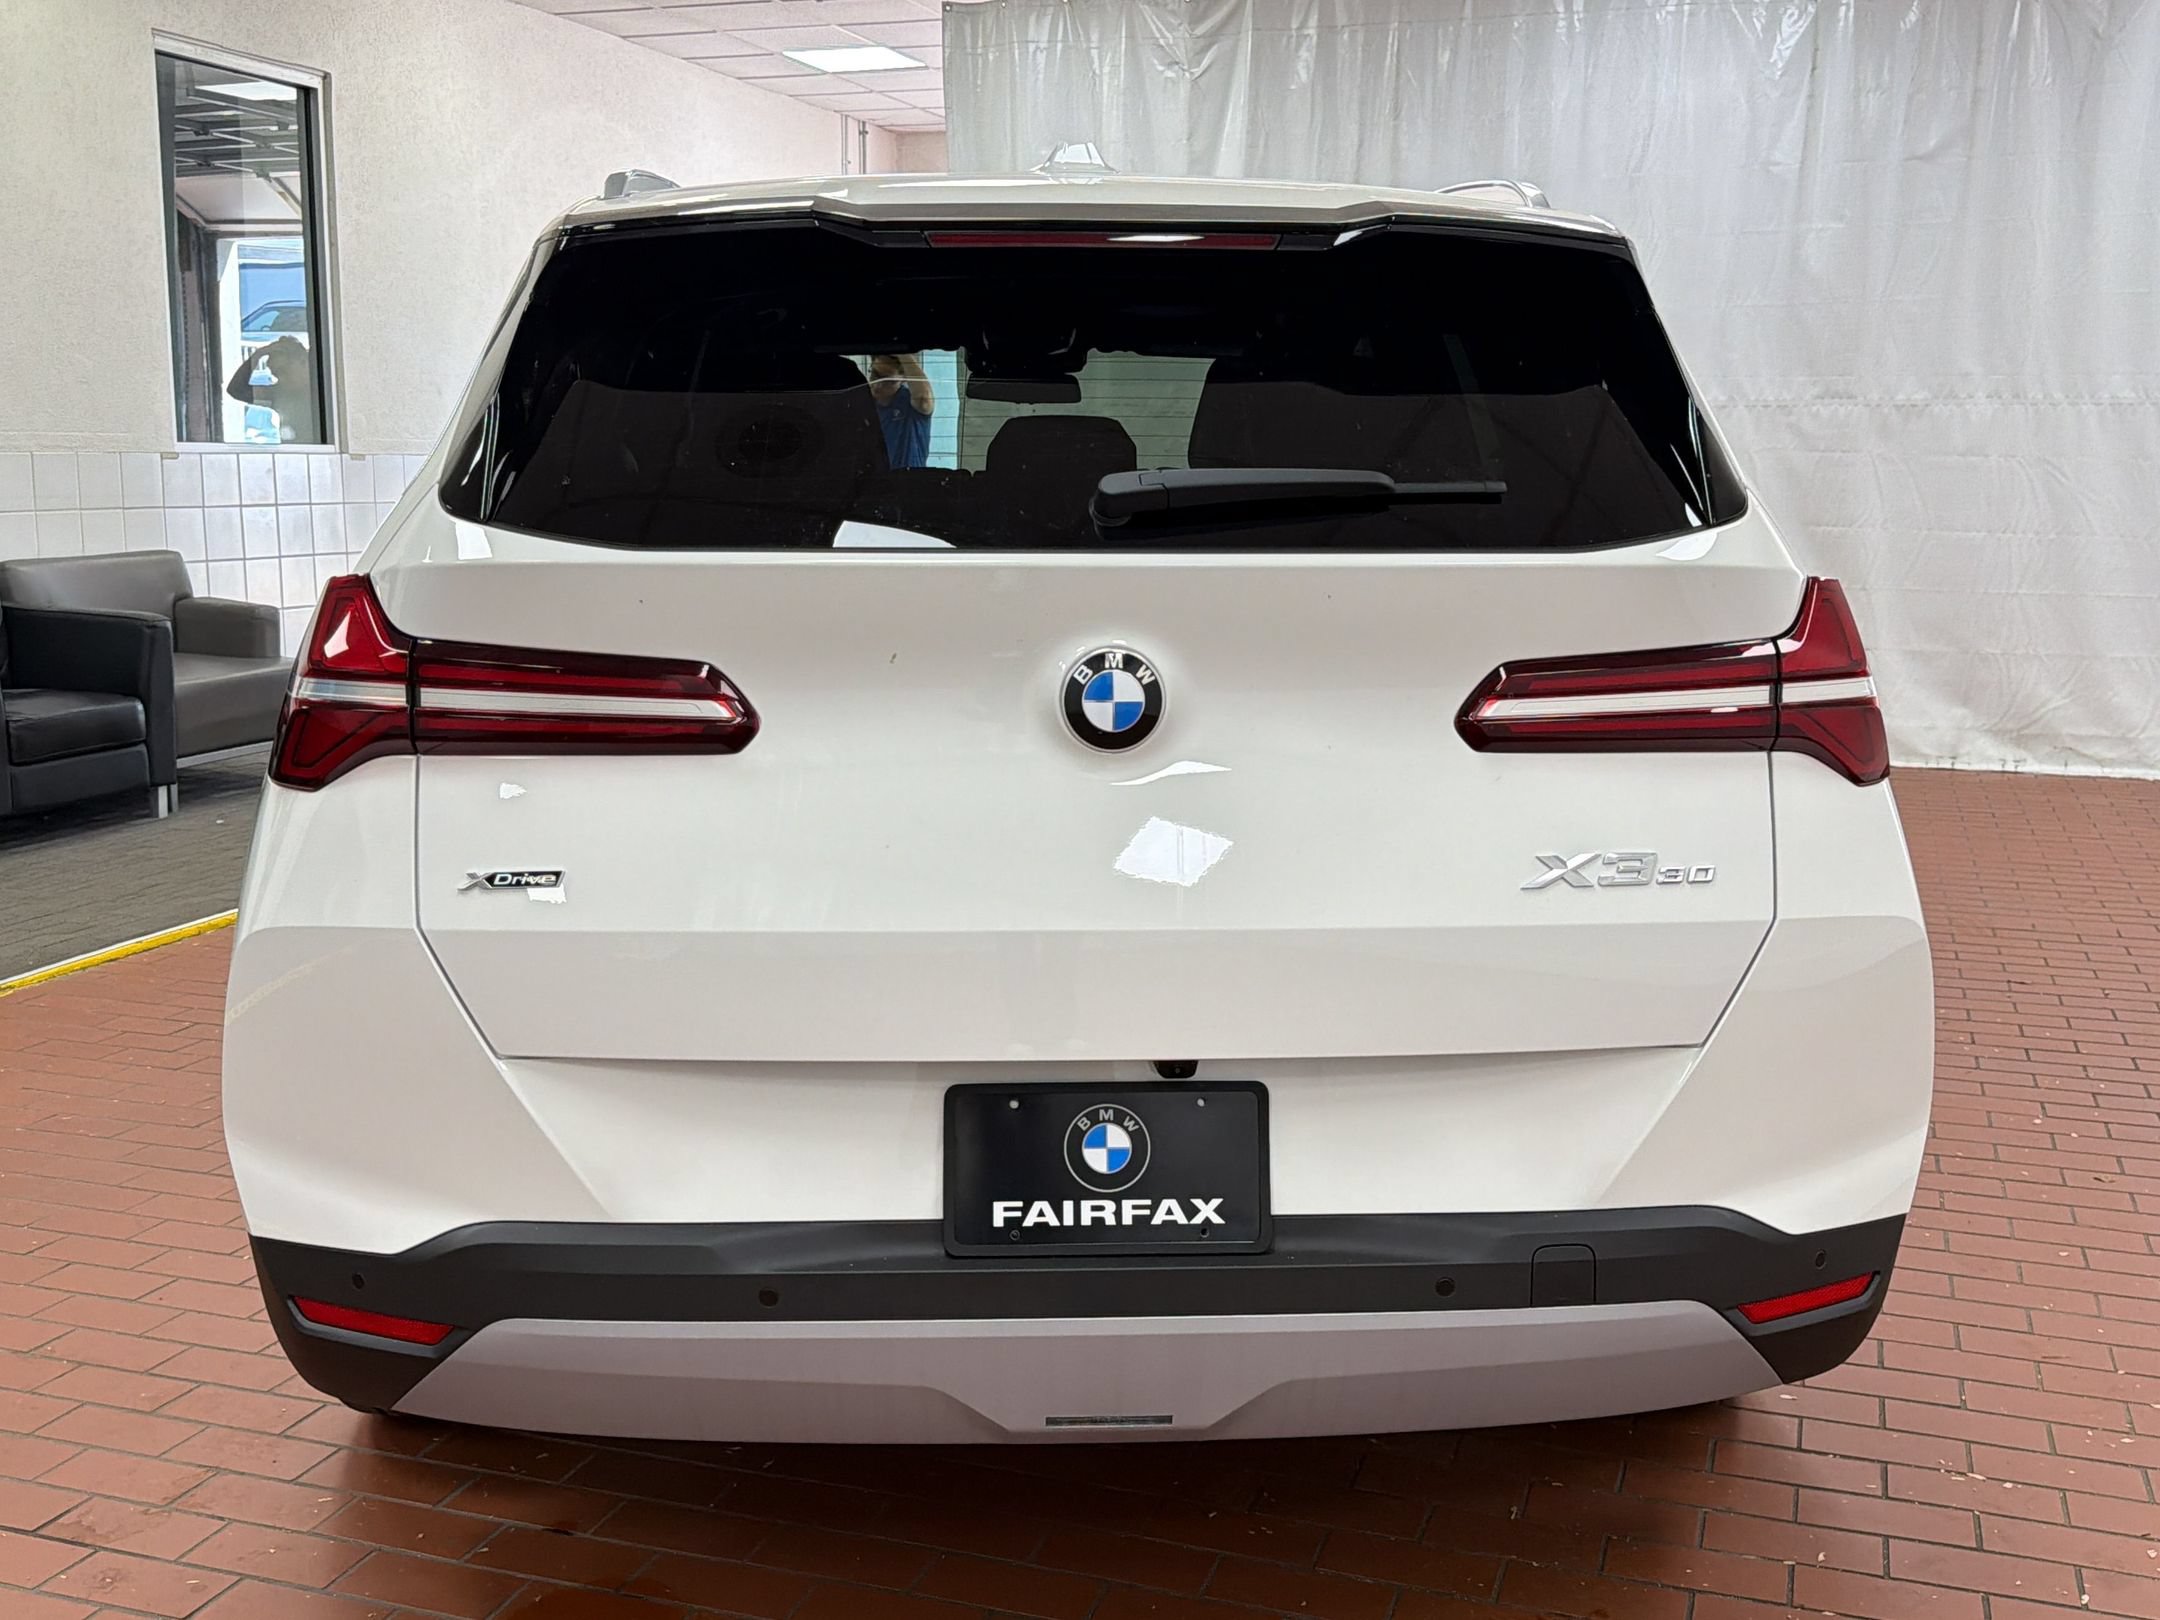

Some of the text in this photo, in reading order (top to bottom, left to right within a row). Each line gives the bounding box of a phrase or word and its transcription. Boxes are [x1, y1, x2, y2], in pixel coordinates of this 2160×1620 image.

[1073, 653, 1156, 685] BMW
[1077, 1108, 1140, 1132] BMW
[992, 1198, 1226, 1228] FAIRFAX
